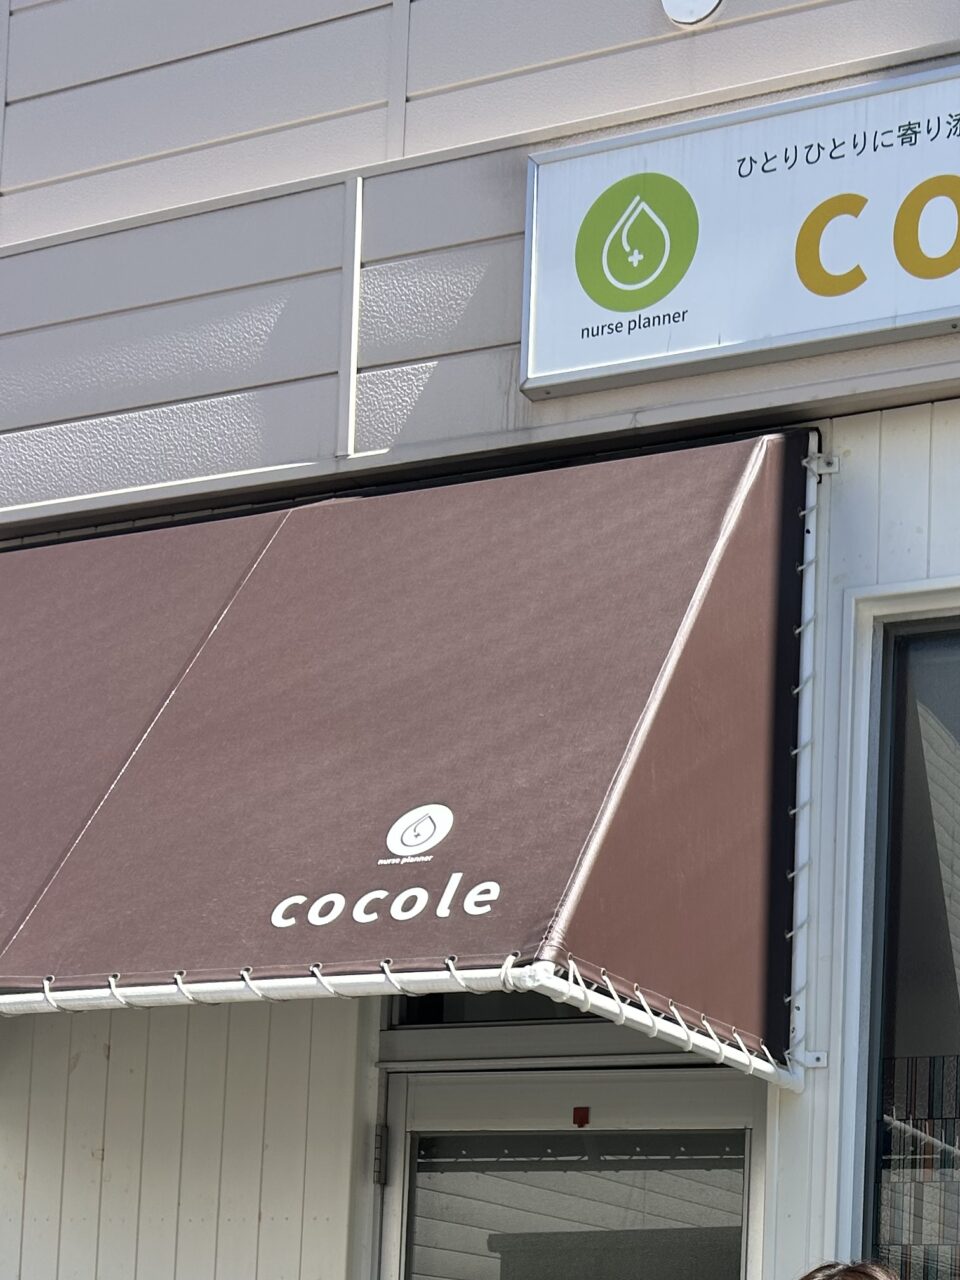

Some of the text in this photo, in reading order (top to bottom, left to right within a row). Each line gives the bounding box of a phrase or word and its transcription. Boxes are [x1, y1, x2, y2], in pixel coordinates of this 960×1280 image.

[581, 309, 688, 339] nurse planner
[270, 872, 501, 928] cocole
